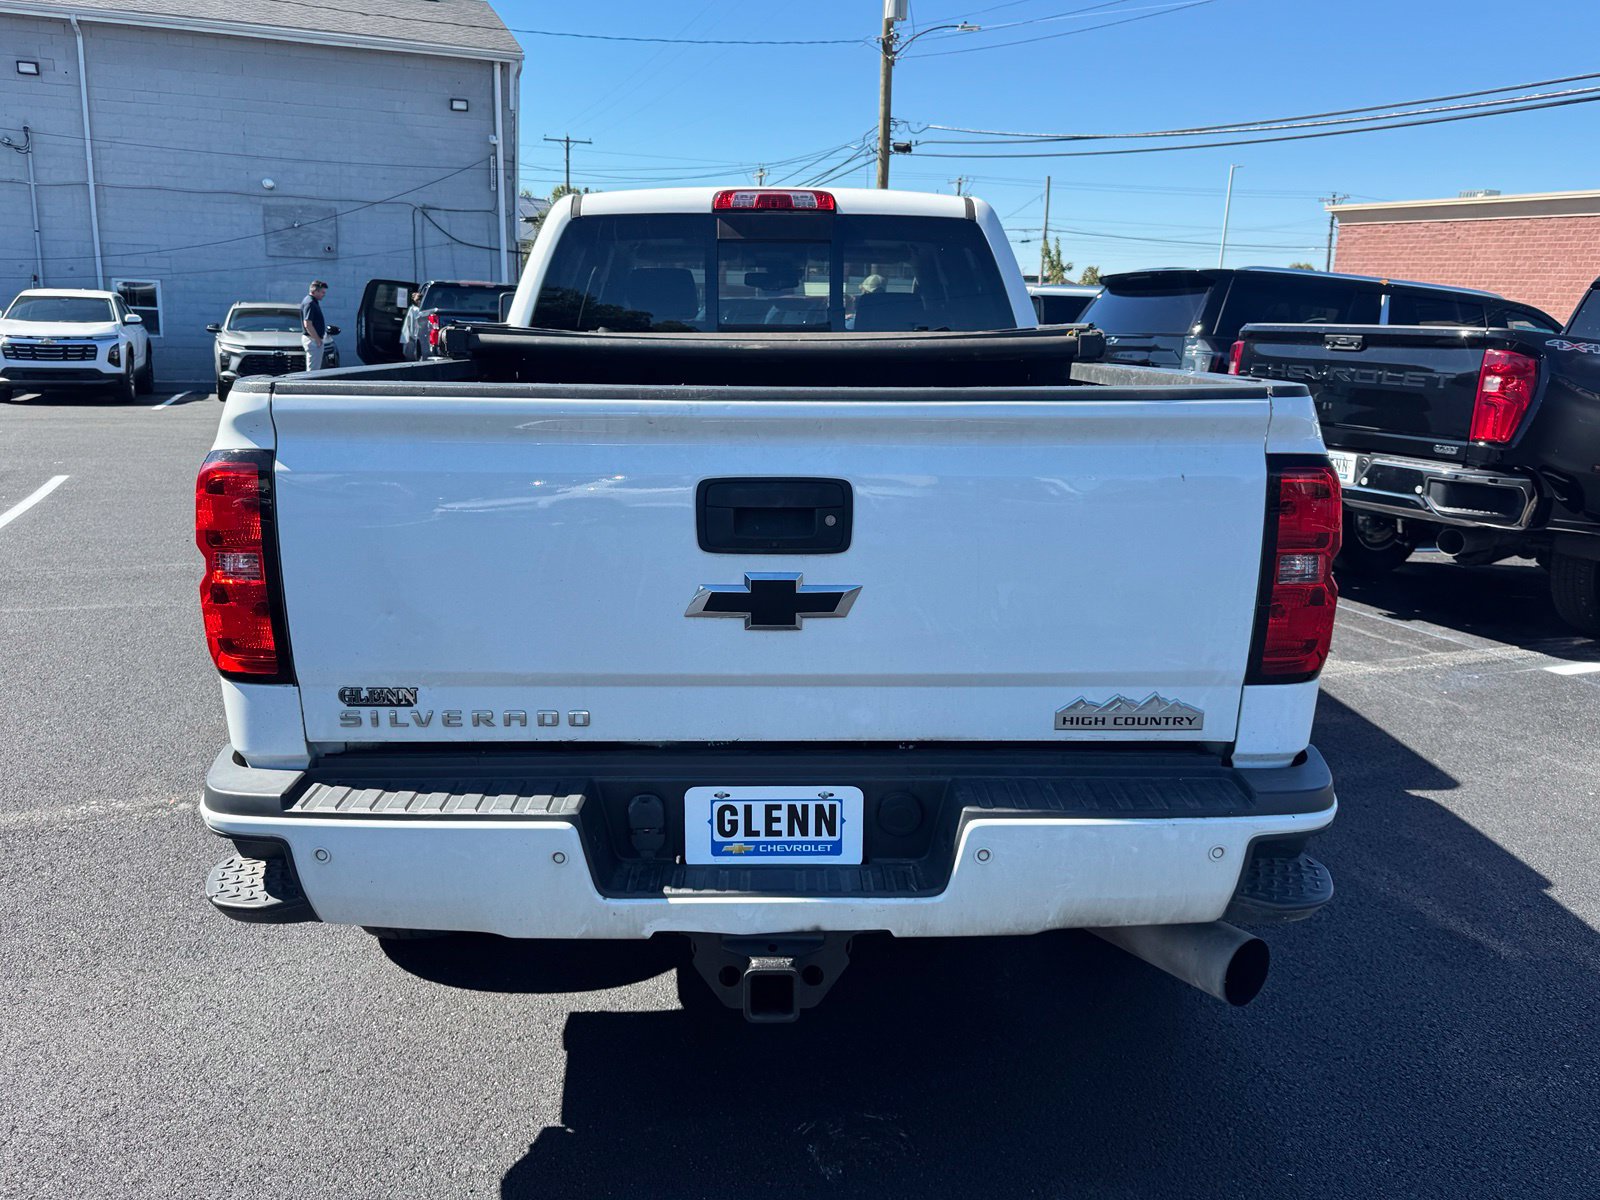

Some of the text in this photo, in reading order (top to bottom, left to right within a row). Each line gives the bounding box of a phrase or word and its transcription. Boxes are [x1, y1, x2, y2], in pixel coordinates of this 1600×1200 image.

[1250, 362, 1457, 390] CHEVROLET
[338, 687, 418, 707] GLENN
[339, 710, 591, 728] SILVERADO
[1062, 716, 1198, 726] HIGH COUNTRY
[716, 803, 837, 838] GLENN
[759, 844, 833, 852] CHEVROLET
